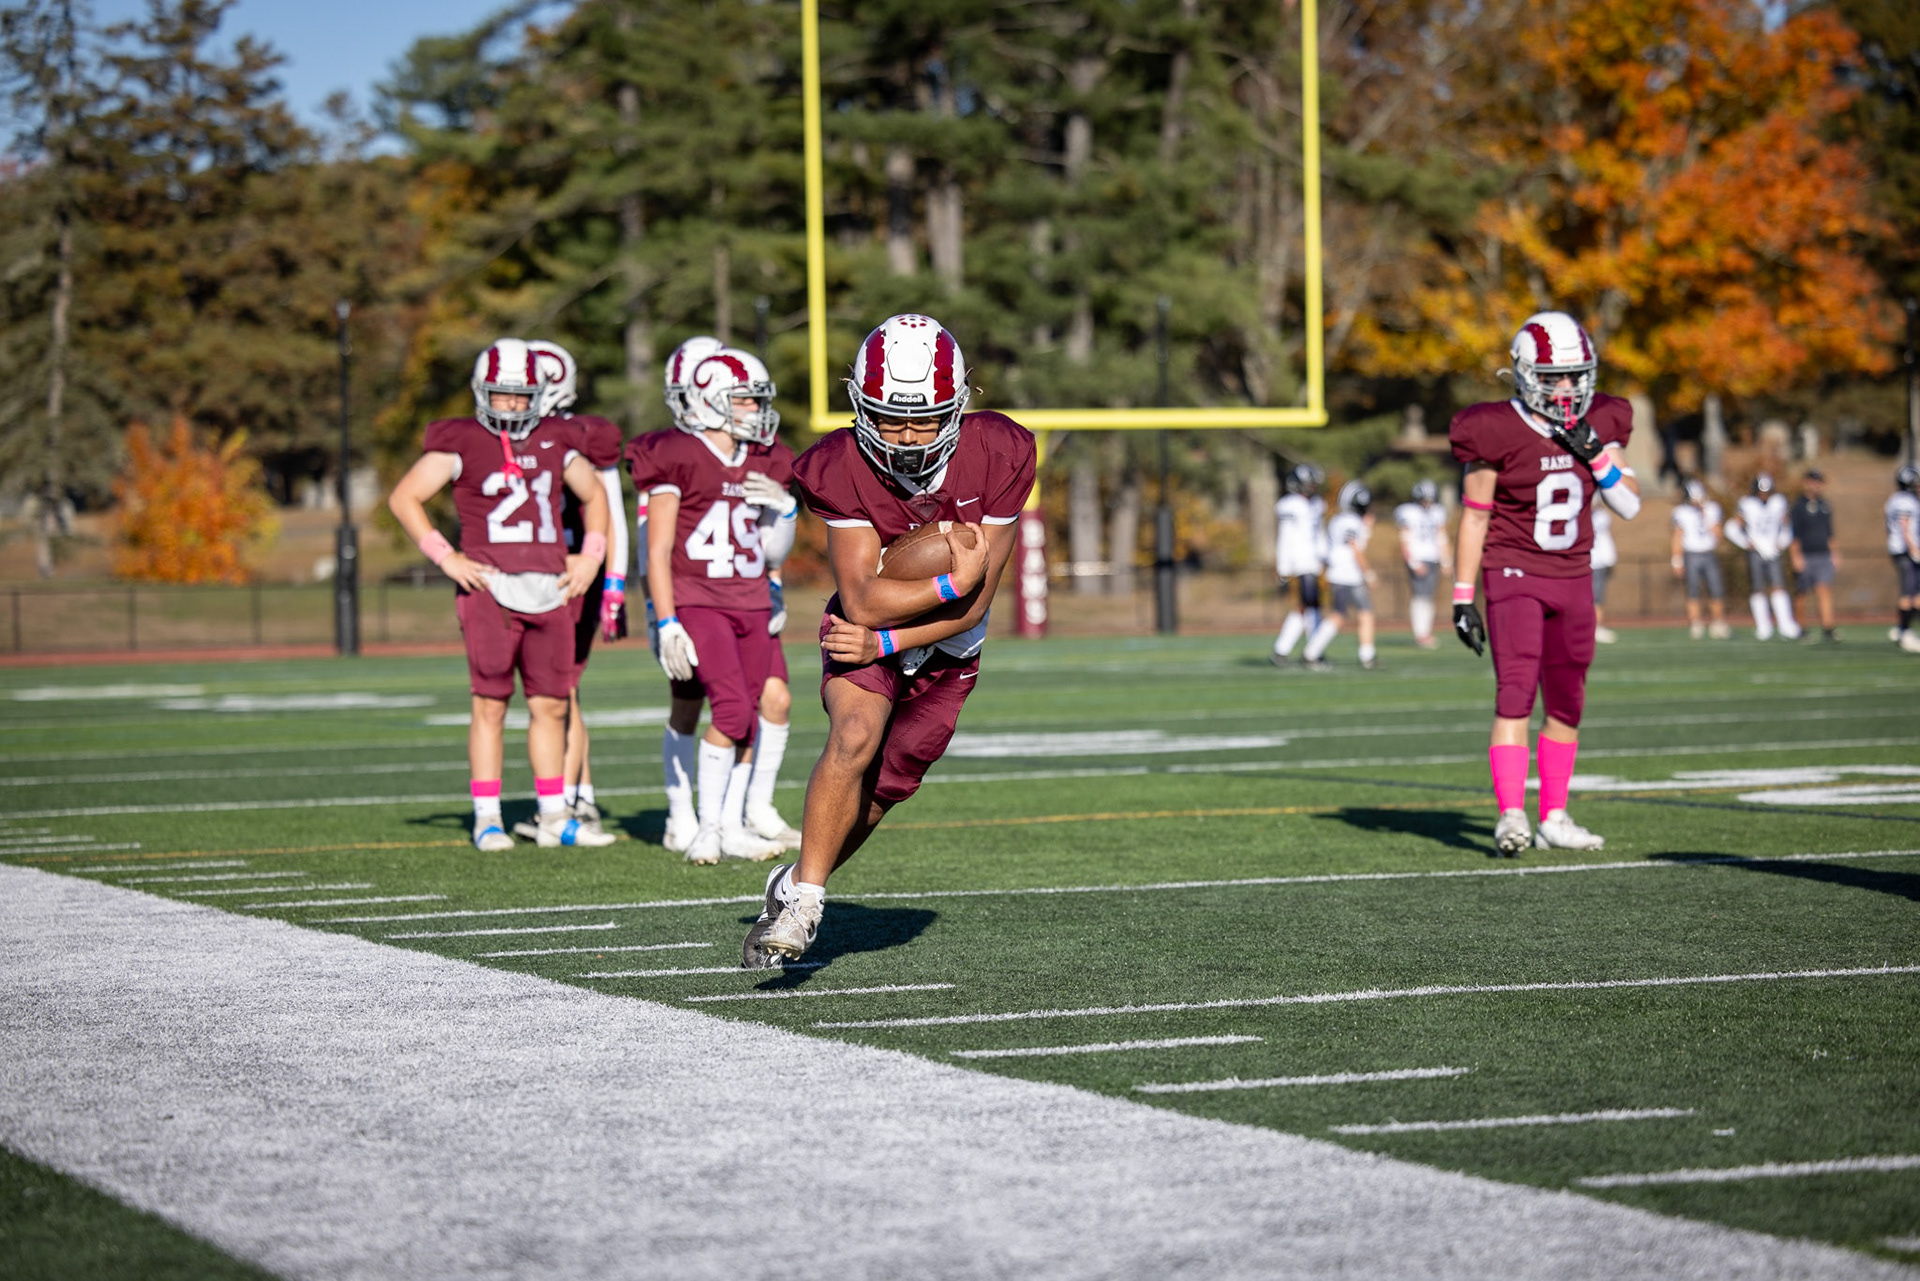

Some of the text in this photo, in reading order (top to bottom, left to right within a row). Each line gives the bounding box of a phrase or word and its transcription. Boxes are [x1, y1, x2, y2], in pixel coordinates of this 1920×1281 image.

[892, 394, 924, 403] Riddell
[1540, 454, 1574, 471] RAMS
[482, 471, 557, 543] 21
[1534, 473, 1583, 551] 8
